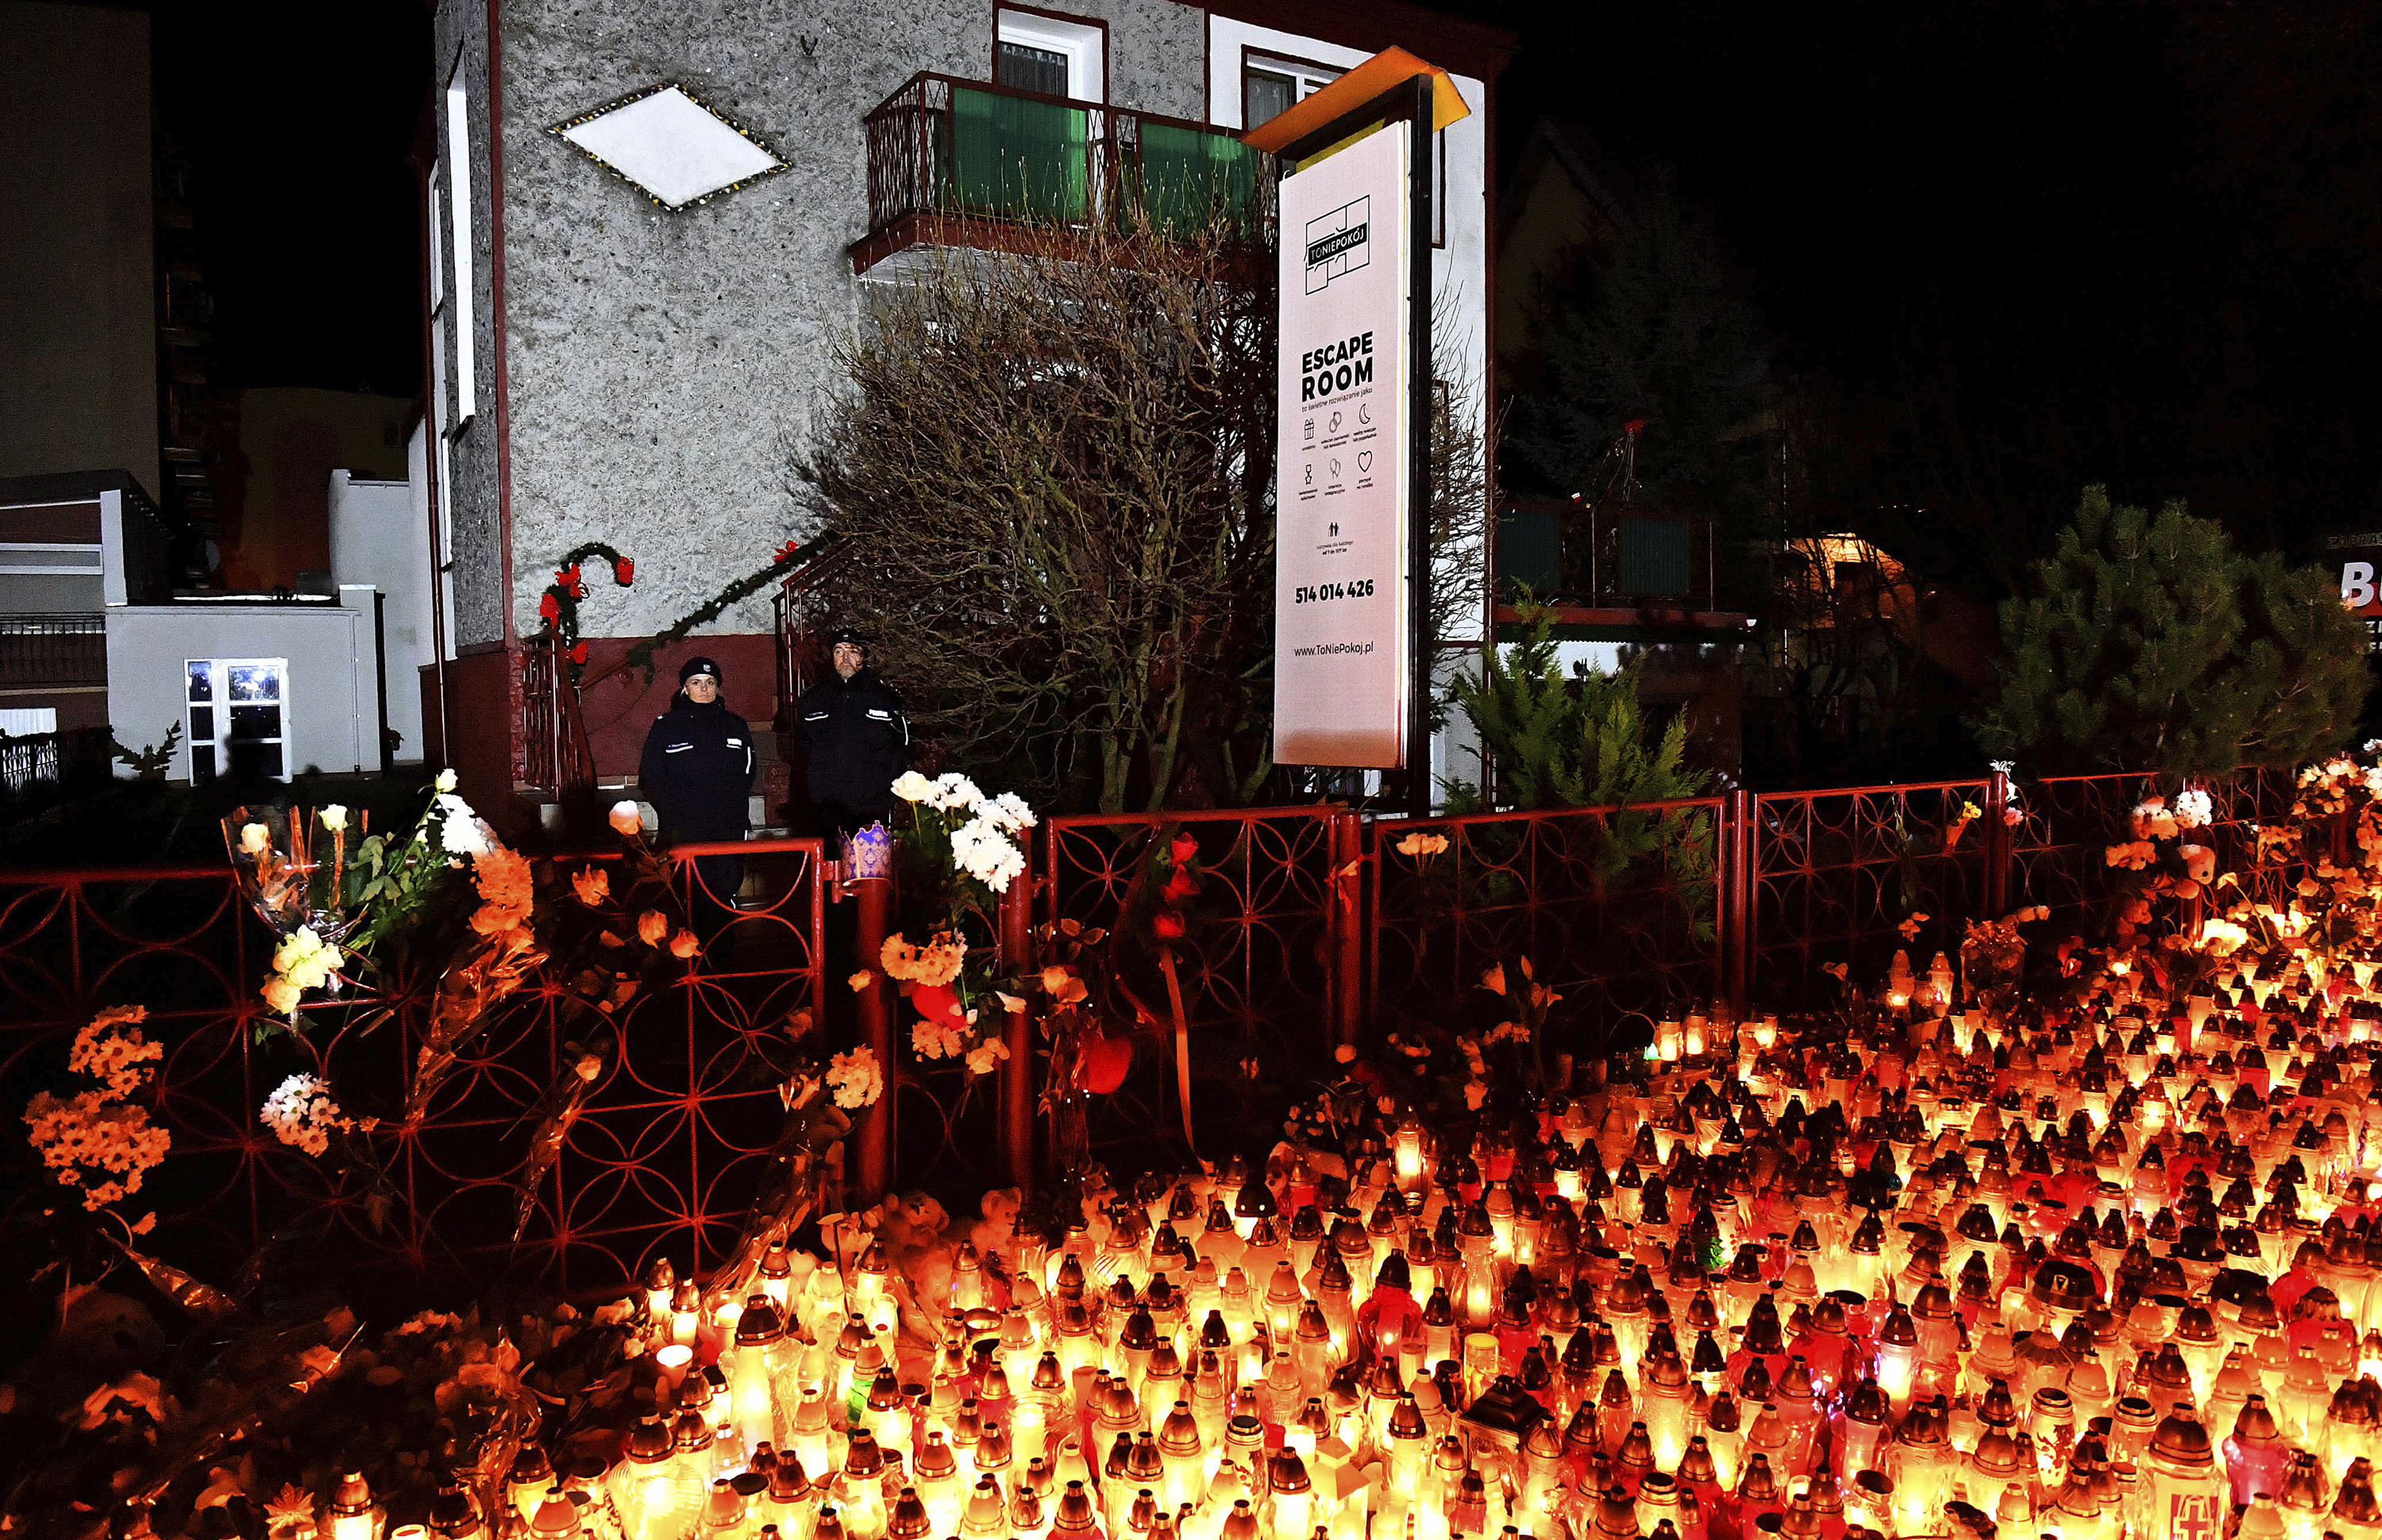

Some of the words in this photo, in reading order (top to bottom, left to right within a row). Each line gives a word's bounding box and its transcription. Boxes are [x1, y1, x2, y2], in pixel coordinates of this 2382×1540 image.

[1310, 228, 1364, 260] TONIEPOKÓJ
[1302, 331, 1373, 374] ESCAPE
[1301, 356, 1373, 402] ROOM
[1328, 391, 1360, 405] rozwiązanie
[1360, 387, 1373, 397] jako
[1295, 586, 1317, 604] 514
[1319, 583, 1344, 602] 014
[1347, 579, 1374, 599] 426
[1294, 641, 1374, 656] www.ToNiePokoj.pl
